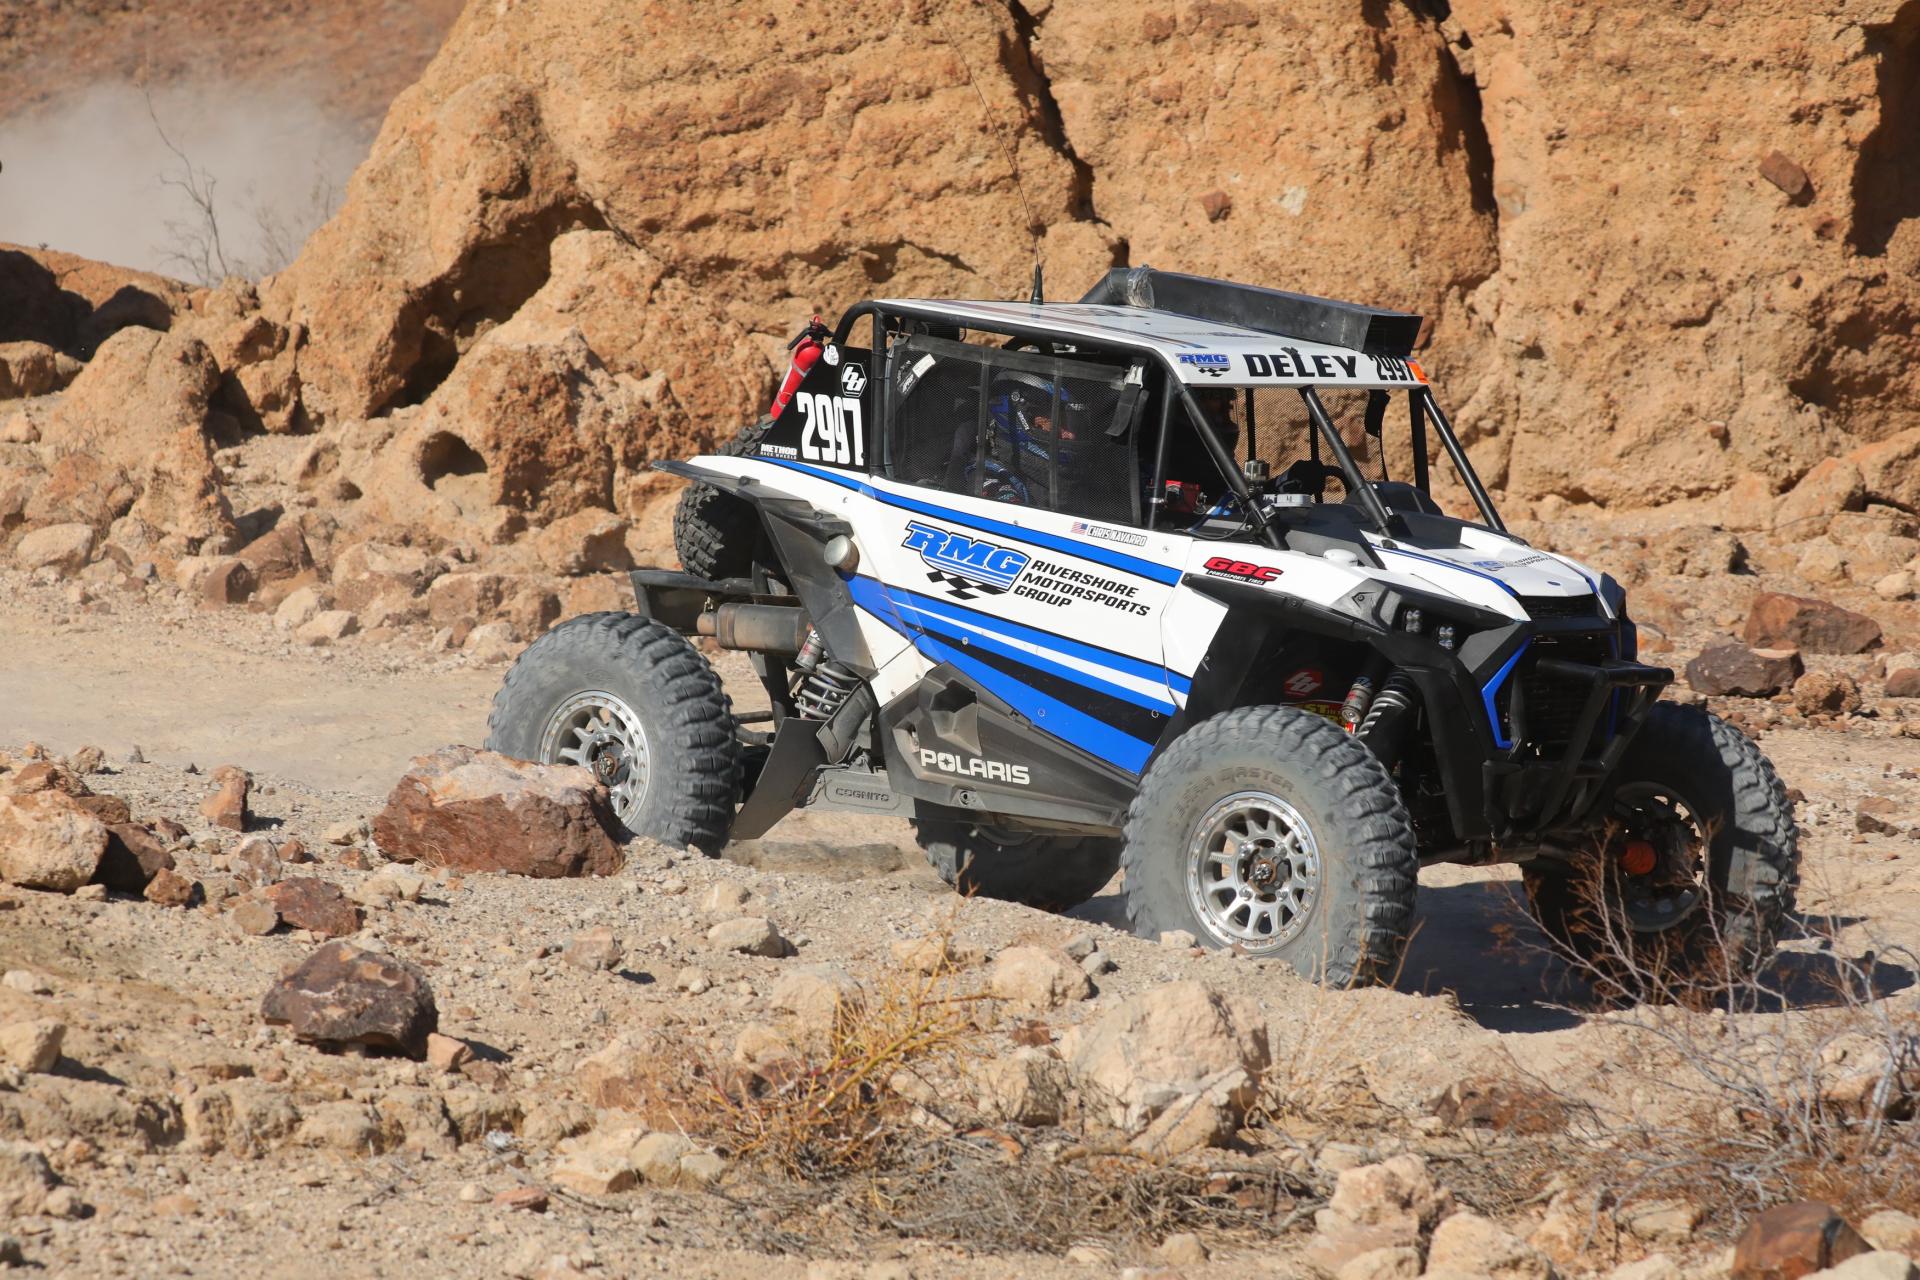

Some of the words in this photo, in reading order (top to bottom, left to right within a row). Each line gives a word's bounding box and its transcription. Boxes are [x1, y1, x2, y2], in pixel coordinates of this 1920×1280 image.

[1175, 353, 1229, 368] RMG
[1242, 347, 1356, 377] DELEY
[797, 392, 864, 466] 2997
[760, 443, 798, 455] METHOD
[1087, 525, 1111, 540] CHRIS
[901, 520, 1032, 580] RMG
[1031, 559, 1139, 598] RIVERSHORE
[1203, 557, 1284, 581] GBC
[1013, 584, 1073, 607] GROUP
[1022, 572, 1151, 616] MOTORSPORTS
[920, 748, 1031, 785] POLARIS
[835, 787, 890, 802] COGNITO
